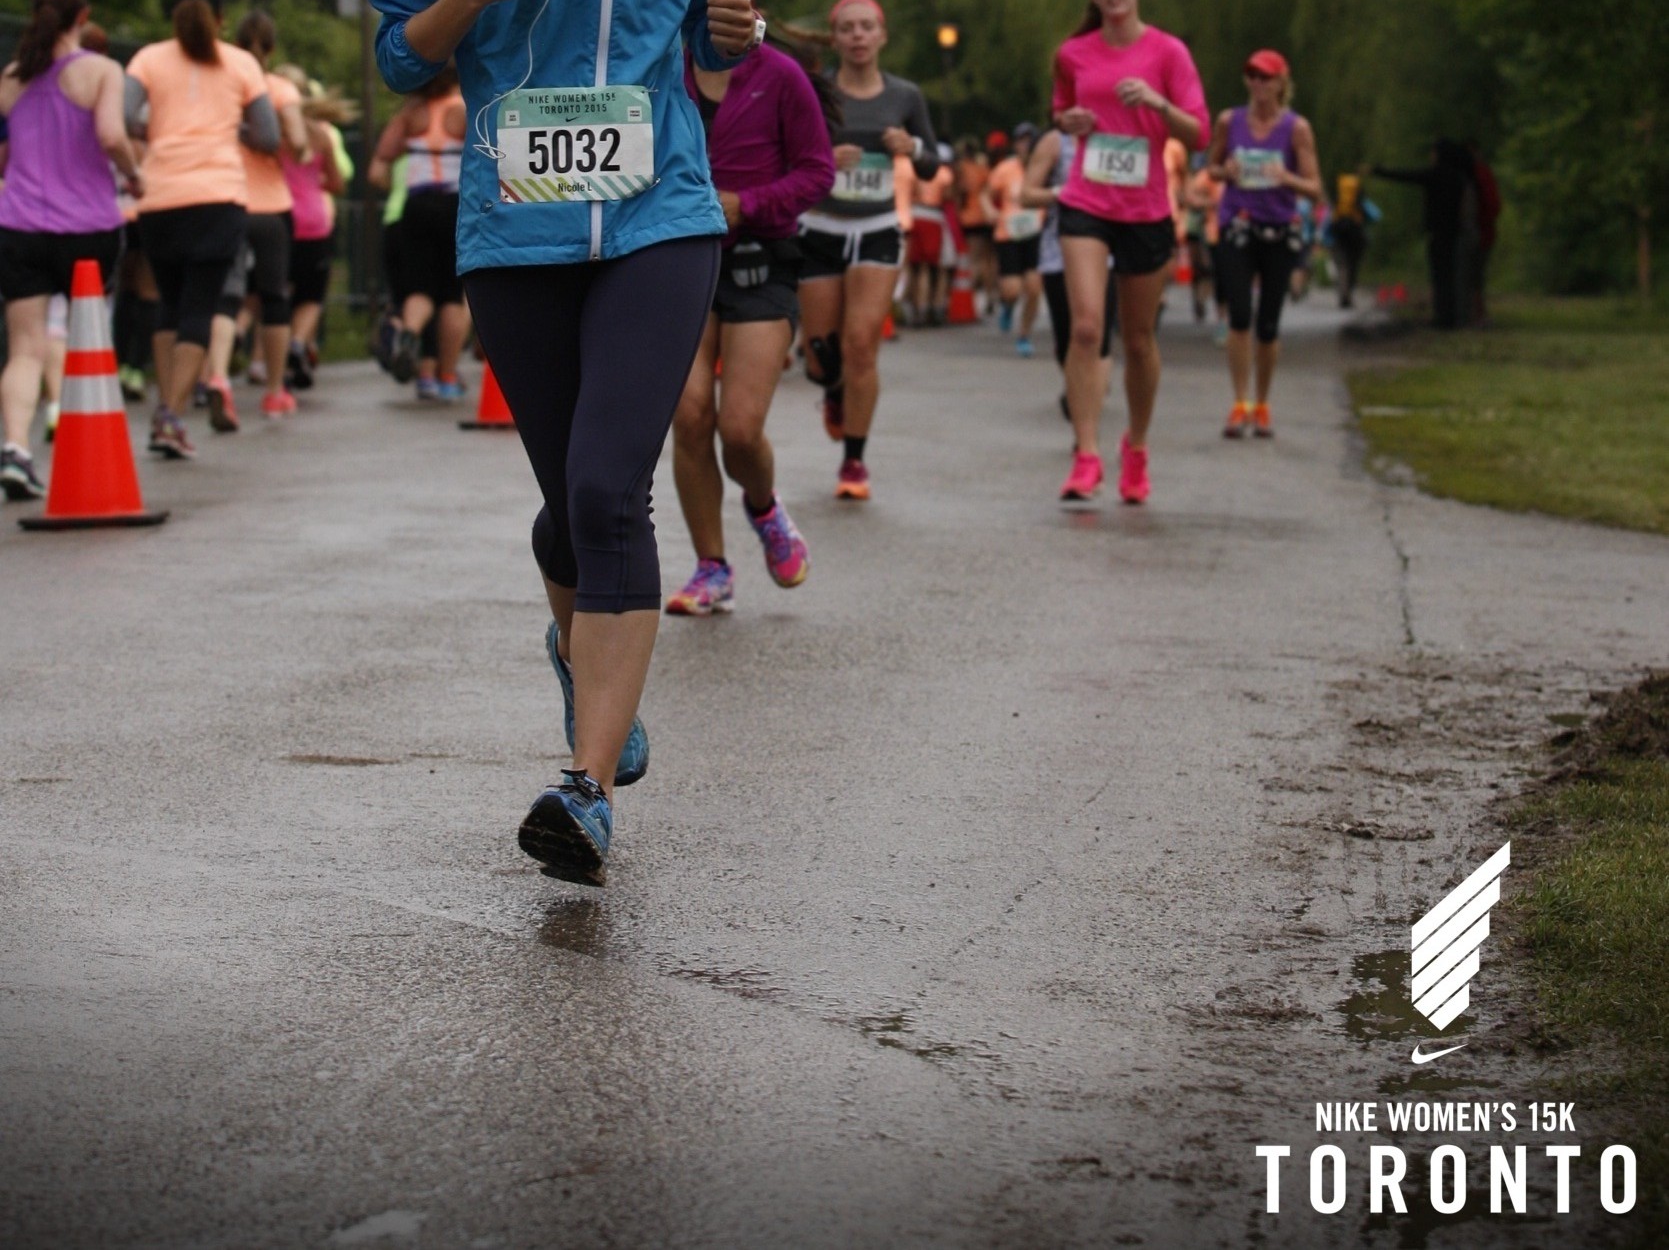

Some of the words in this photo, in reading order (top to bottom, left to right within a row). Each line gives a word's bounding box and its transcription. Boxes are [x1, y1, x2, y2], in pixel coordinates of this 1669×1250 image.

[528, 95, 549, 104] NIKE
[553, 93, 596, 103] WOMEN'S
[539, 105, 581, 114] TORONTO
[584, 104, 607, 113] 2015
[529, 127, 621, 175] 5032
[557, 182, 585, 193] Nicole
